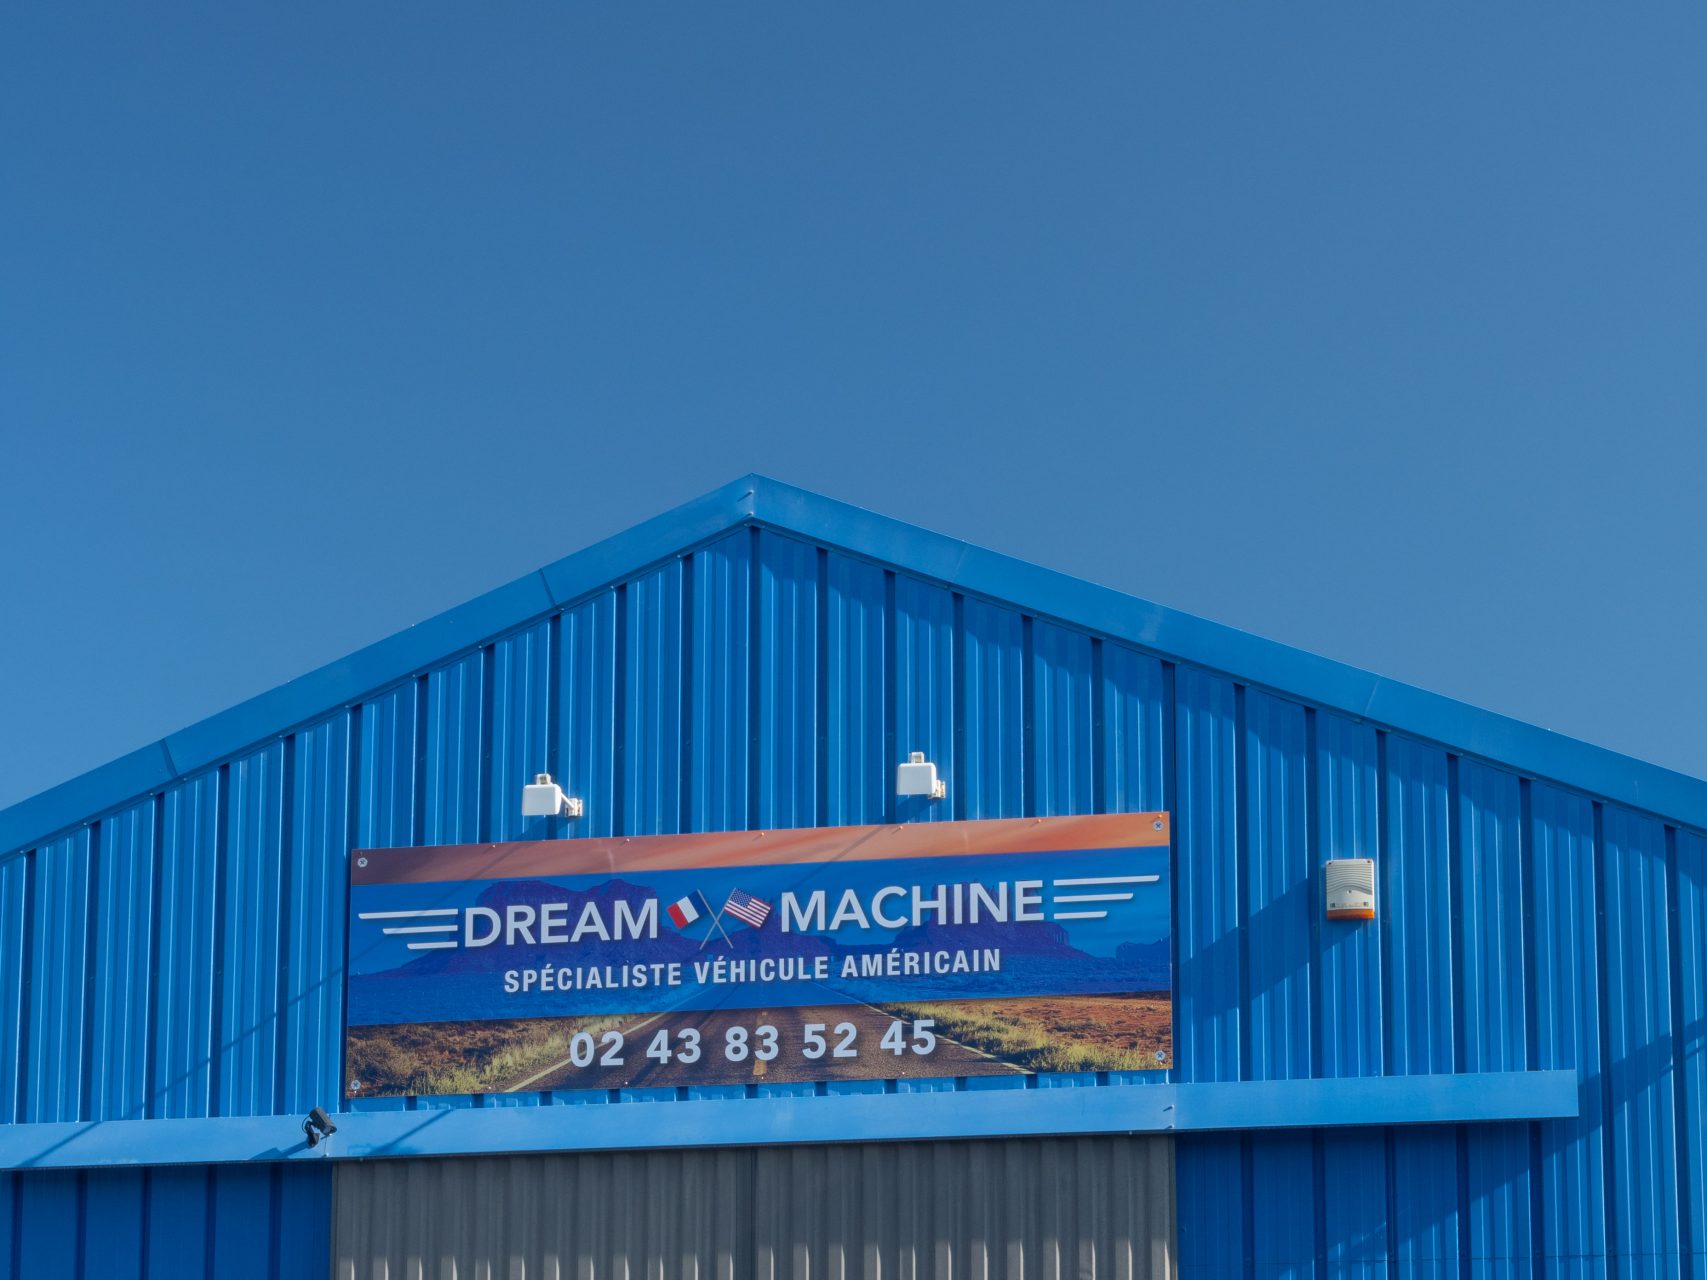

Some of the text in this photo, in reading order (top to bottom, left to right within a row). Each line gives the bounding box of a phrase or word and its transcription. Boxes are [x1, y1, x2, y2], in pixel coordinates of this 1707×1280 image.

[465, 879, 1045, 948] DREAM MACHINE
[504, 947, 1001, 993] SPÉCIALISTE VÉHICULE AMÉRICAIN
[569, 1019, 936, 1068] 02 43 83 52 45
